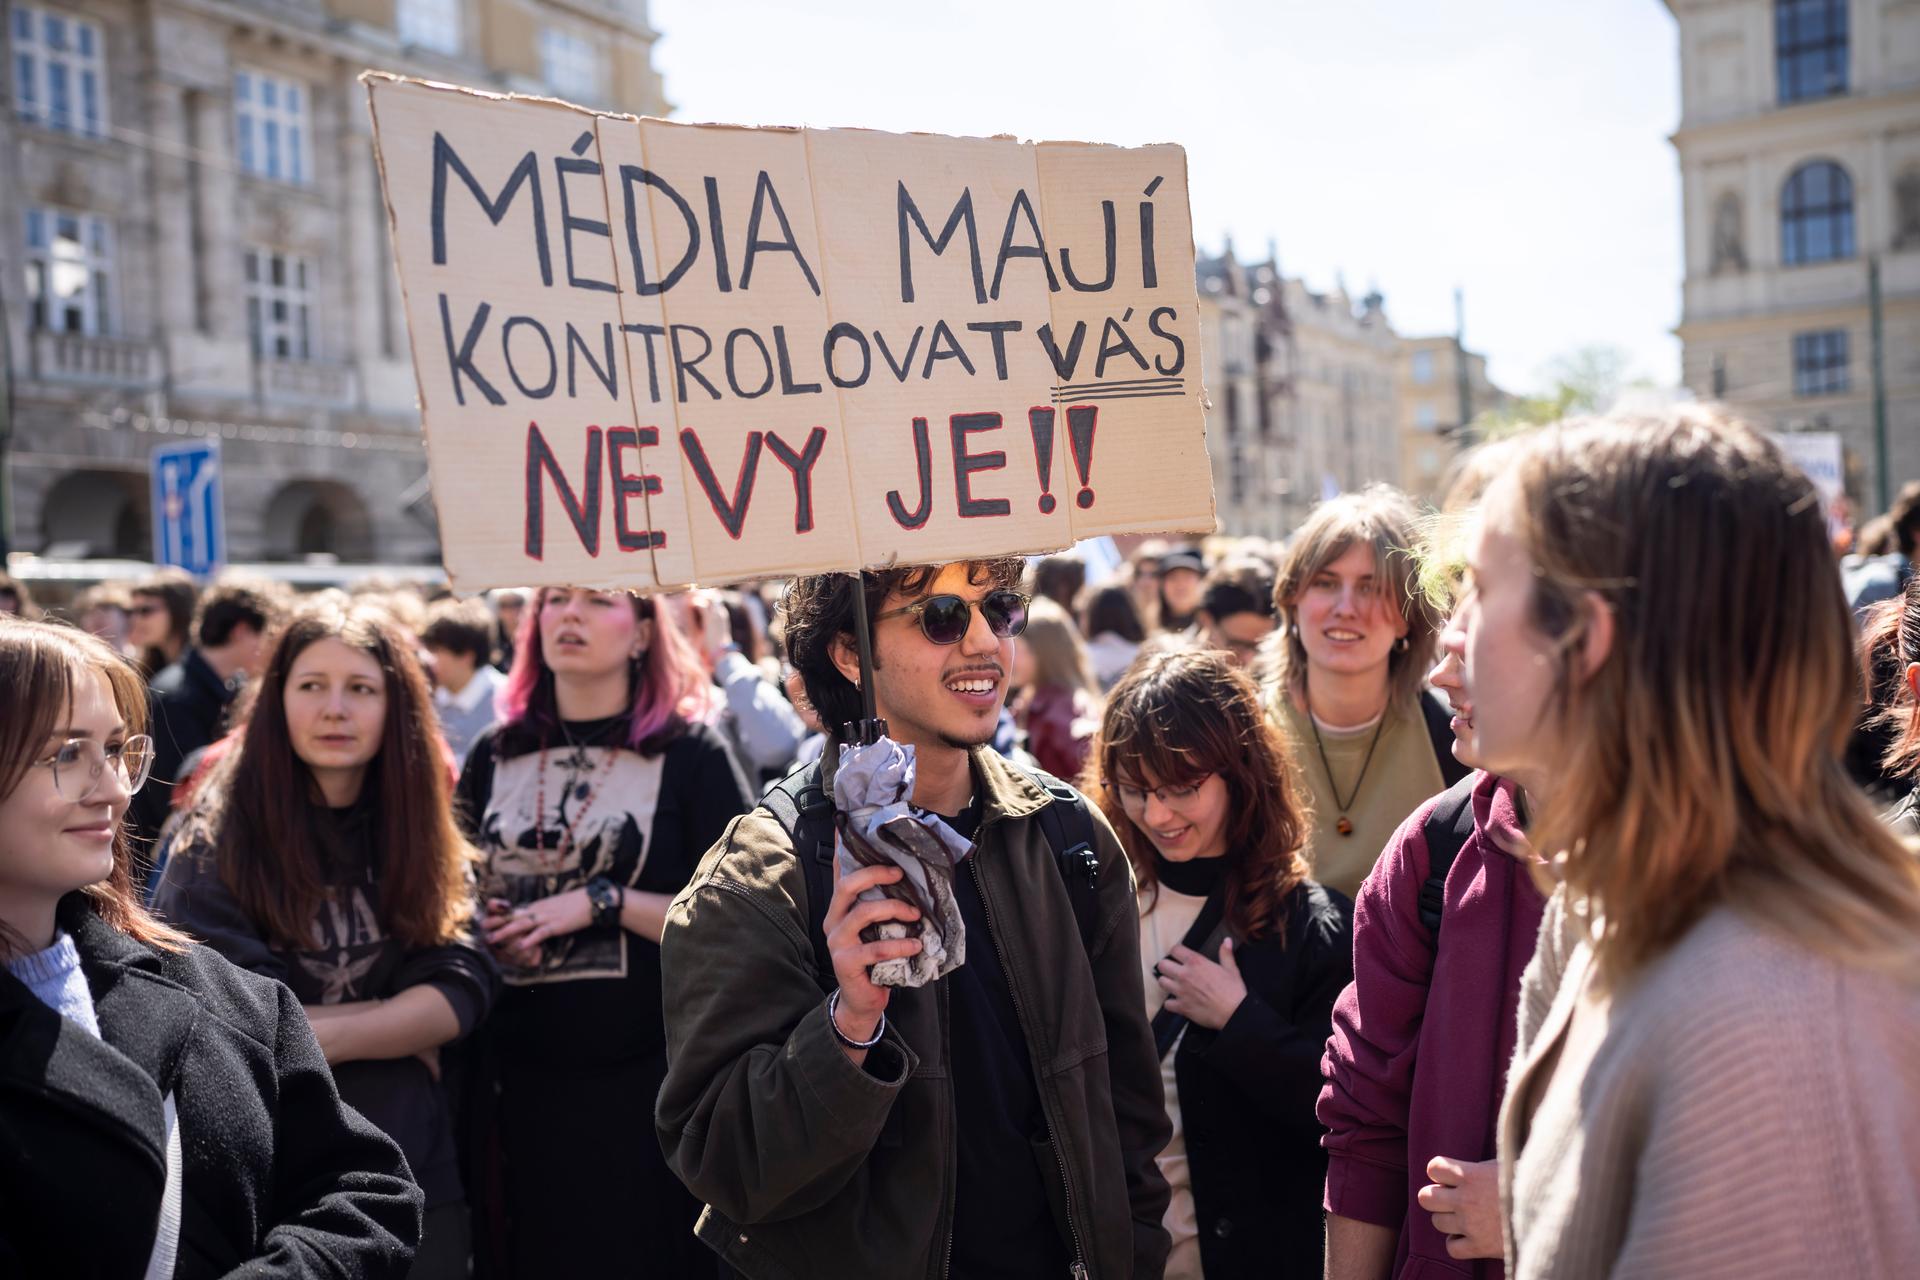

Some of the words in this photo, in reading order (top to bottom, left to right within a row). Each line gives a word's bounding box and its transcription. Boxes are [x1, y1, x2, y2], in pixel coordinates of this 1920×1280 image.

[431, 131, 821, 297] MÉDIA
[897, 175, 1164, 304] MAJÍ
[438, 293, 1023, 406] KONTROLOVAT
[1036, 306, 1185, 382] VÁS
[885, 405, 1099, 531] JE!!
